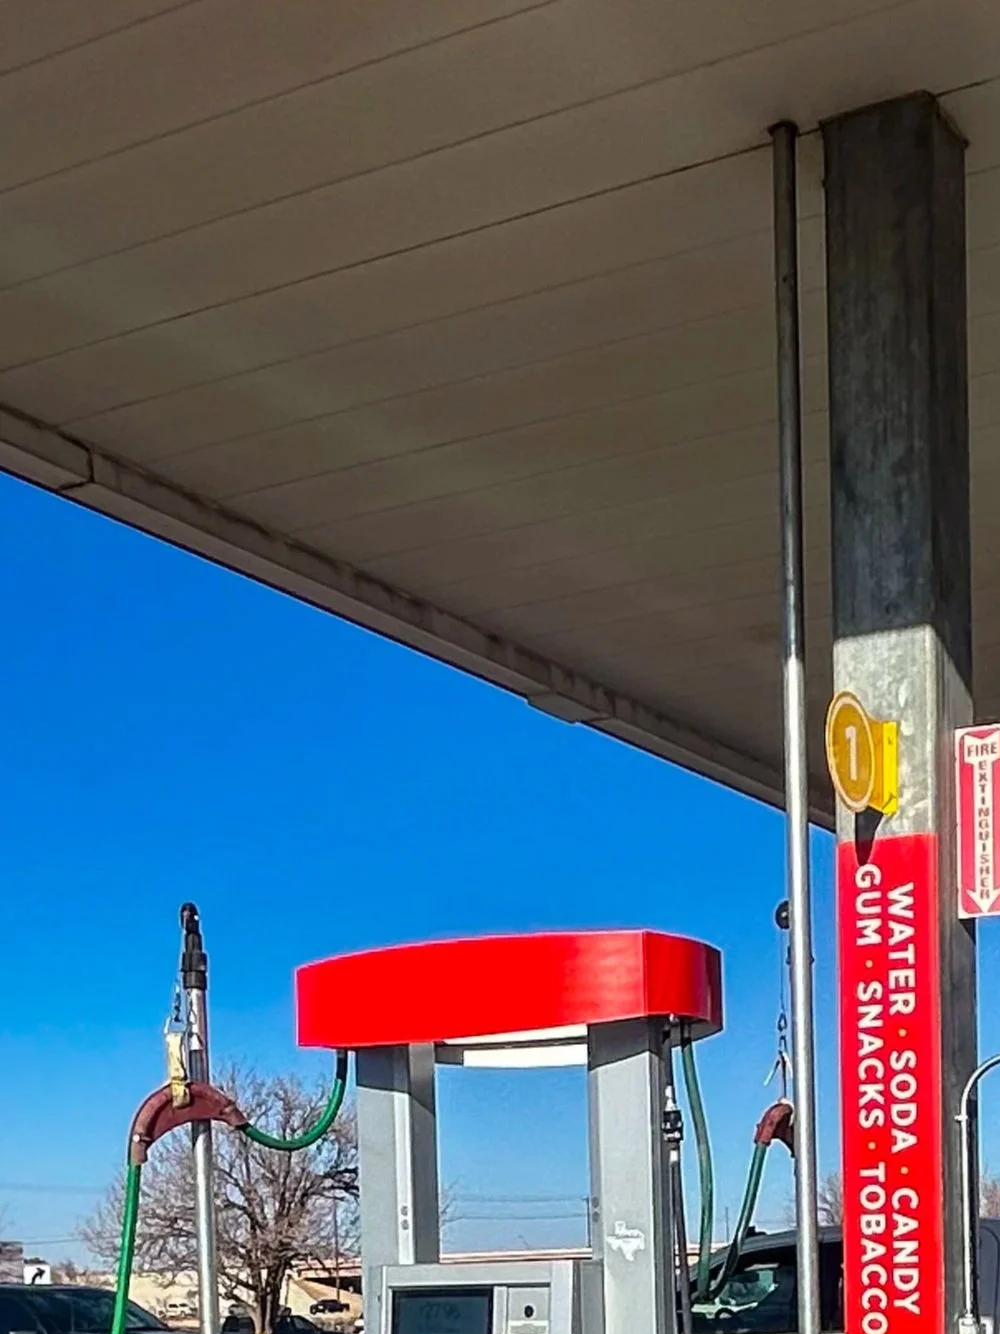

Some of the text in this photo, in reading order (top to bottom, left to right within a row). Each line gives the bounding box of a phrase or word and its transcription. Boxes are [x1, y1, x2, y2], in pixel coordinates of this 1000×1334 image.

[845, 725, 858, 782] 1
[967, 742, 998, 757] FIRE
[978, 759, 990, 900] EXTINGUISHER
[855, 863, 882, 946] GUM
[856, 981, 885, 1129] SNACKS
[887, 882, 920, 1315] WATER SODA CANDY
